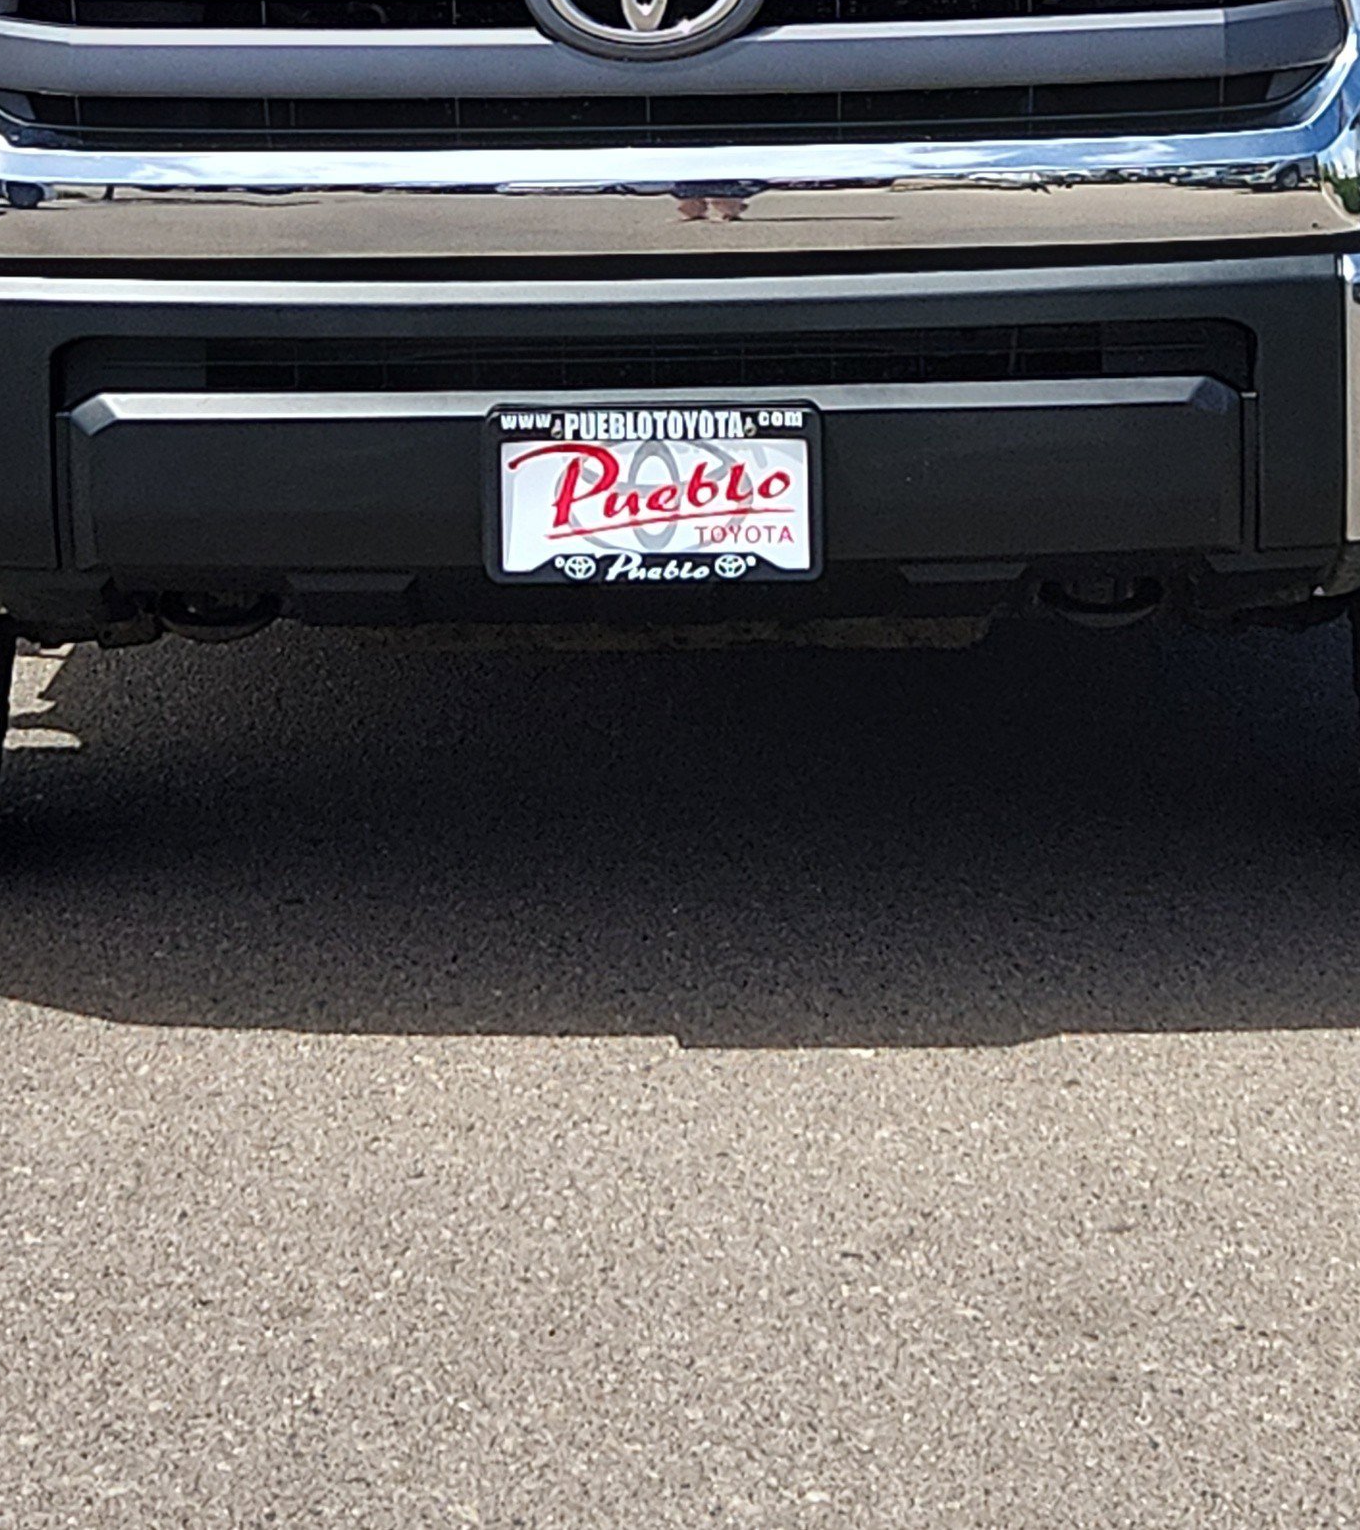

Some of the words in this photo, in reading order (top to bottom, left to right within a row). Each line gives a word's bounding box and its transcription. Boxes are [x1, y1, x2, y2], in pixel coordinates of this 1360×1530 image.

[507, 443, 791, 528] Pueblo
[694, 525, 794, 544] TOYOTA
[595, 552, 710, 581] Pueblo
